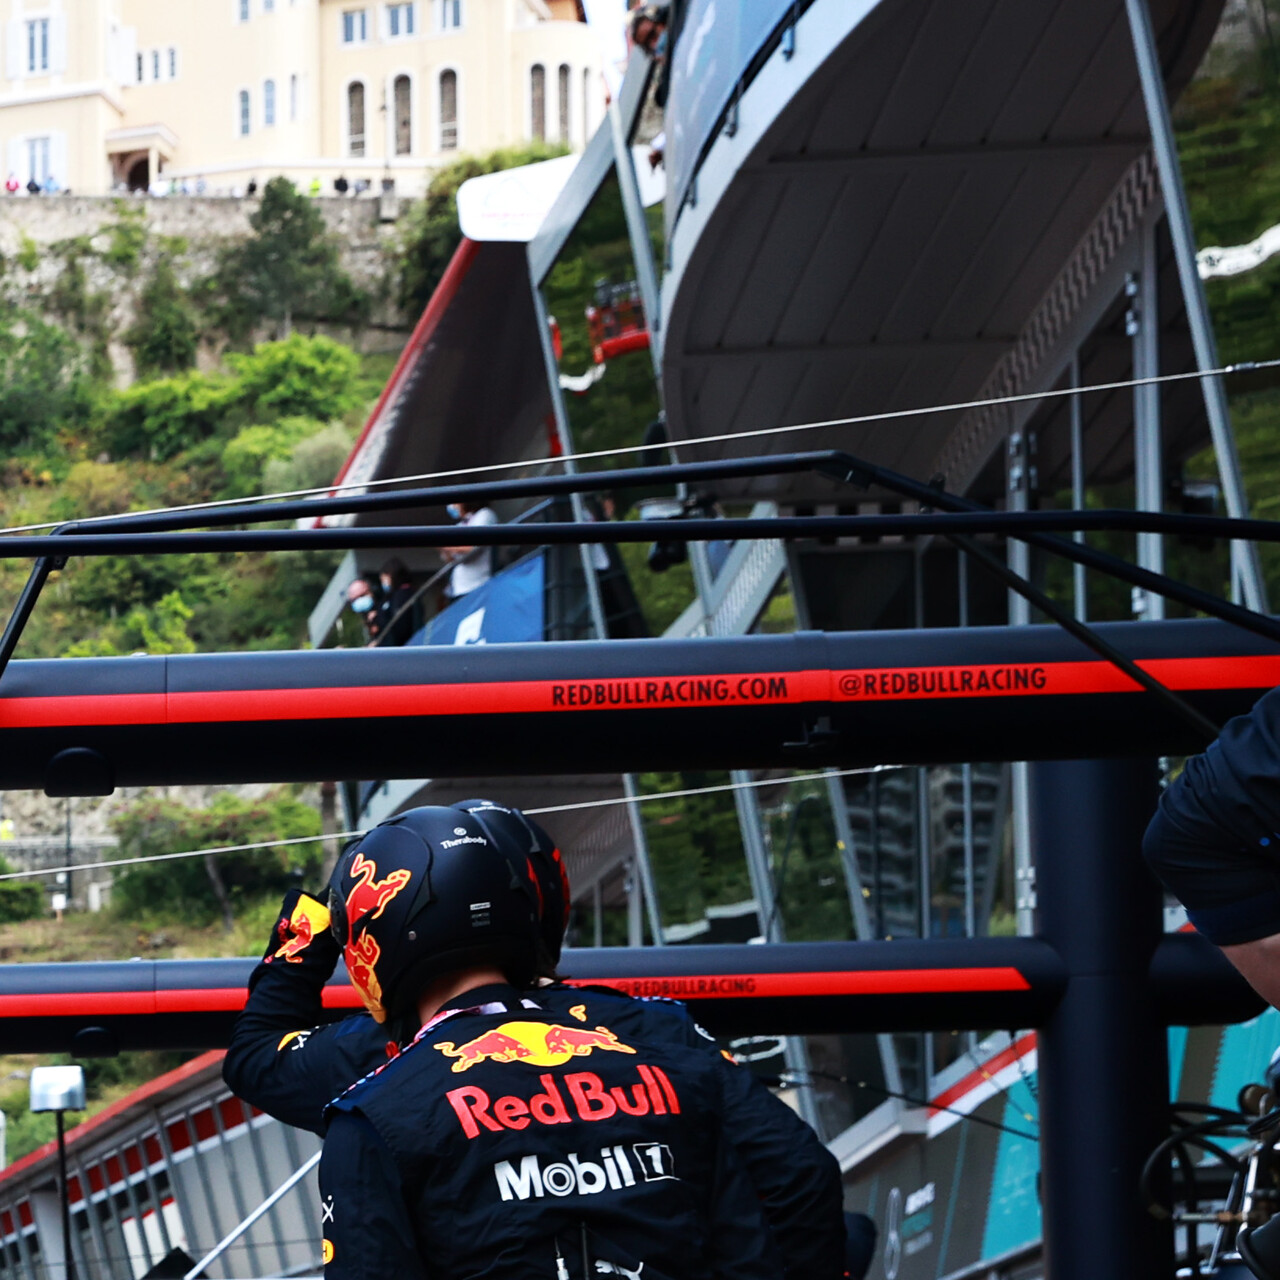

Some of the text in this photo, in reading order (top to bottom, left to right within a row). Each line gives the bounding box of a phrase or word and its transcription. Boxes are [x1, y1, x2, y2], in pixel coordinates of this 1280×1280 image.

[552, 677, 788, 706] REDBULLRACING.COM
[839, 668, 1046, 696] @REDBULLRACING
[446, 1064, 680, 1139] Red Bull
[494, 1145, 636, 1201] Mobil
